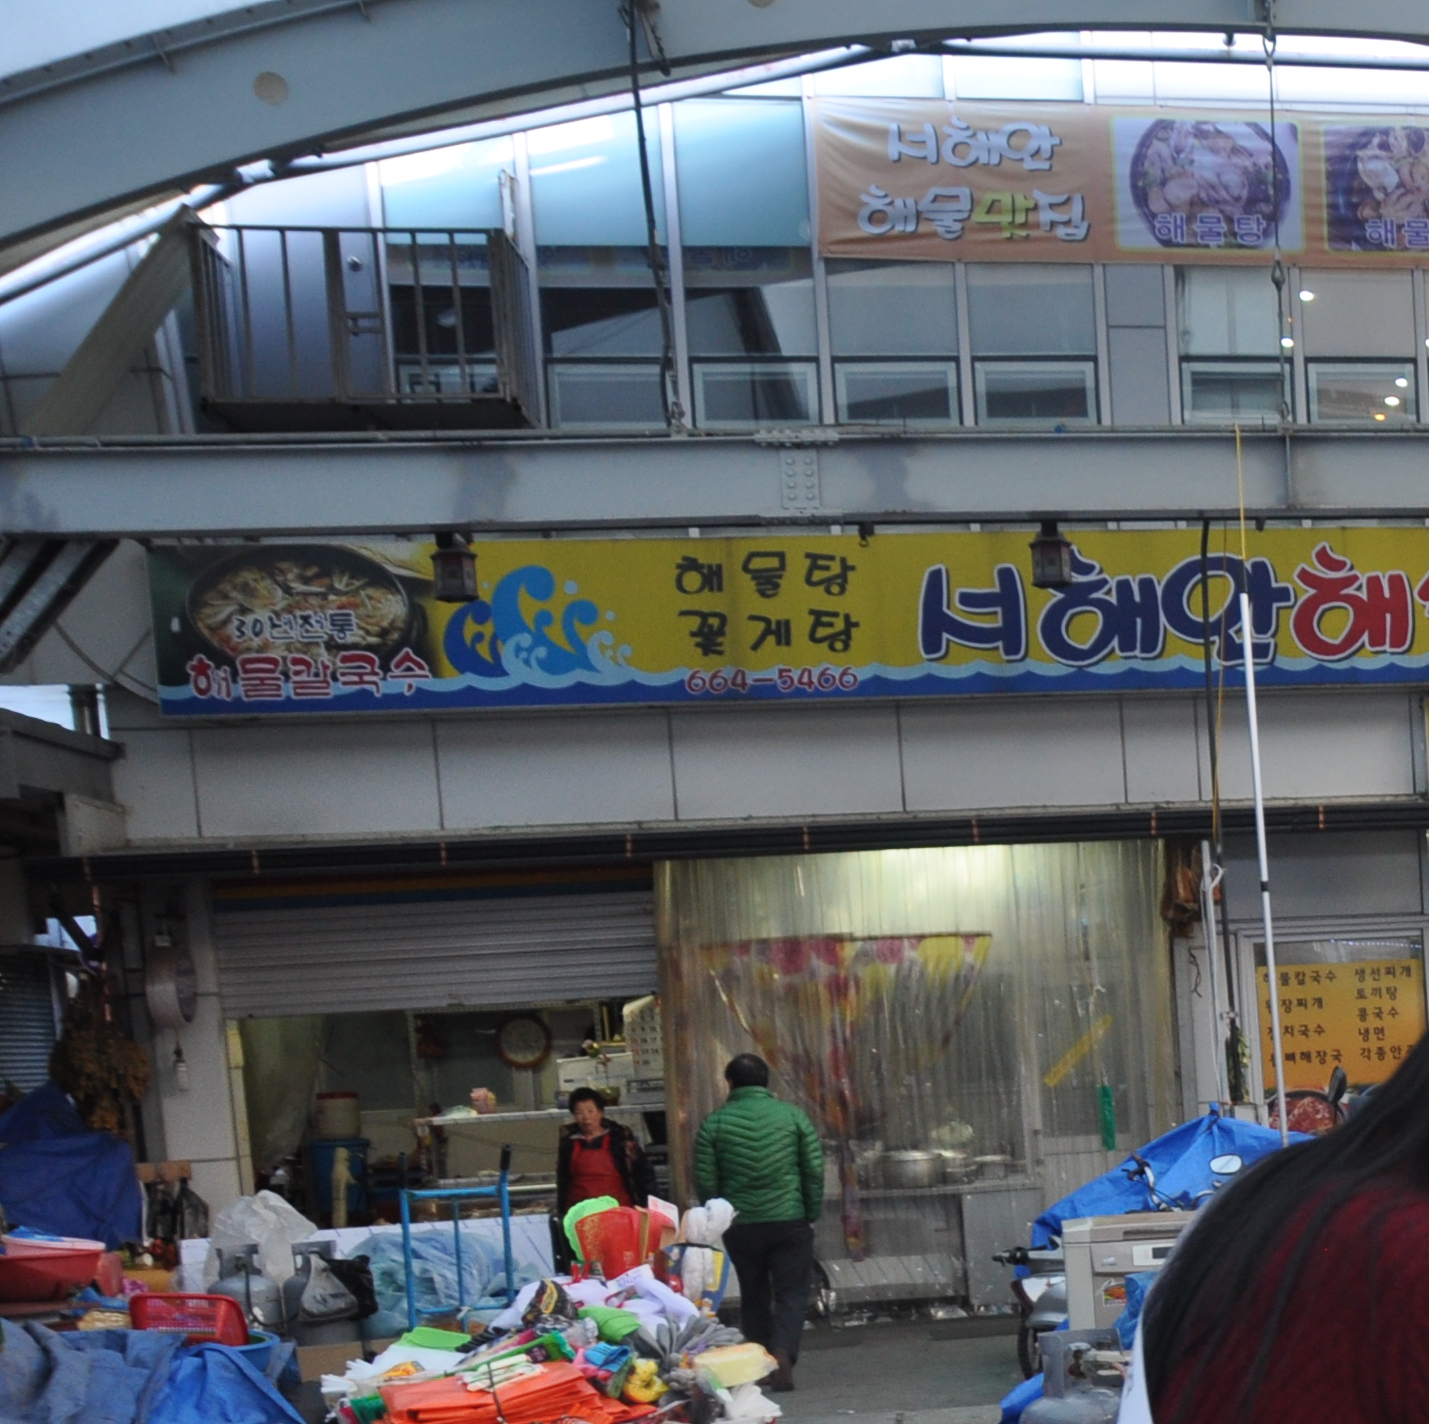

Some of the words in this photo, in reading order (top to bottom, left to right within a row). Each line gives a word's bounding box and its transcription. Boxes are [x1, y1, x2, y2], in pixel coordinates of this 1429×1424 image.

[887, 121, 1060, 174] 서해안
[857, 184, 1090, 243] 해물맛집
[1153, 212, 1267, 247] 해물탕
[674, 548, 857, 599] 해물탕
[686, 608, 861, 657] 꽃게탕
[186, 647, 432, 703] 해물칼국수
[685, 664, 860, 694] 664-5466
[1358, 1026, 1386, 1042] 냉면
